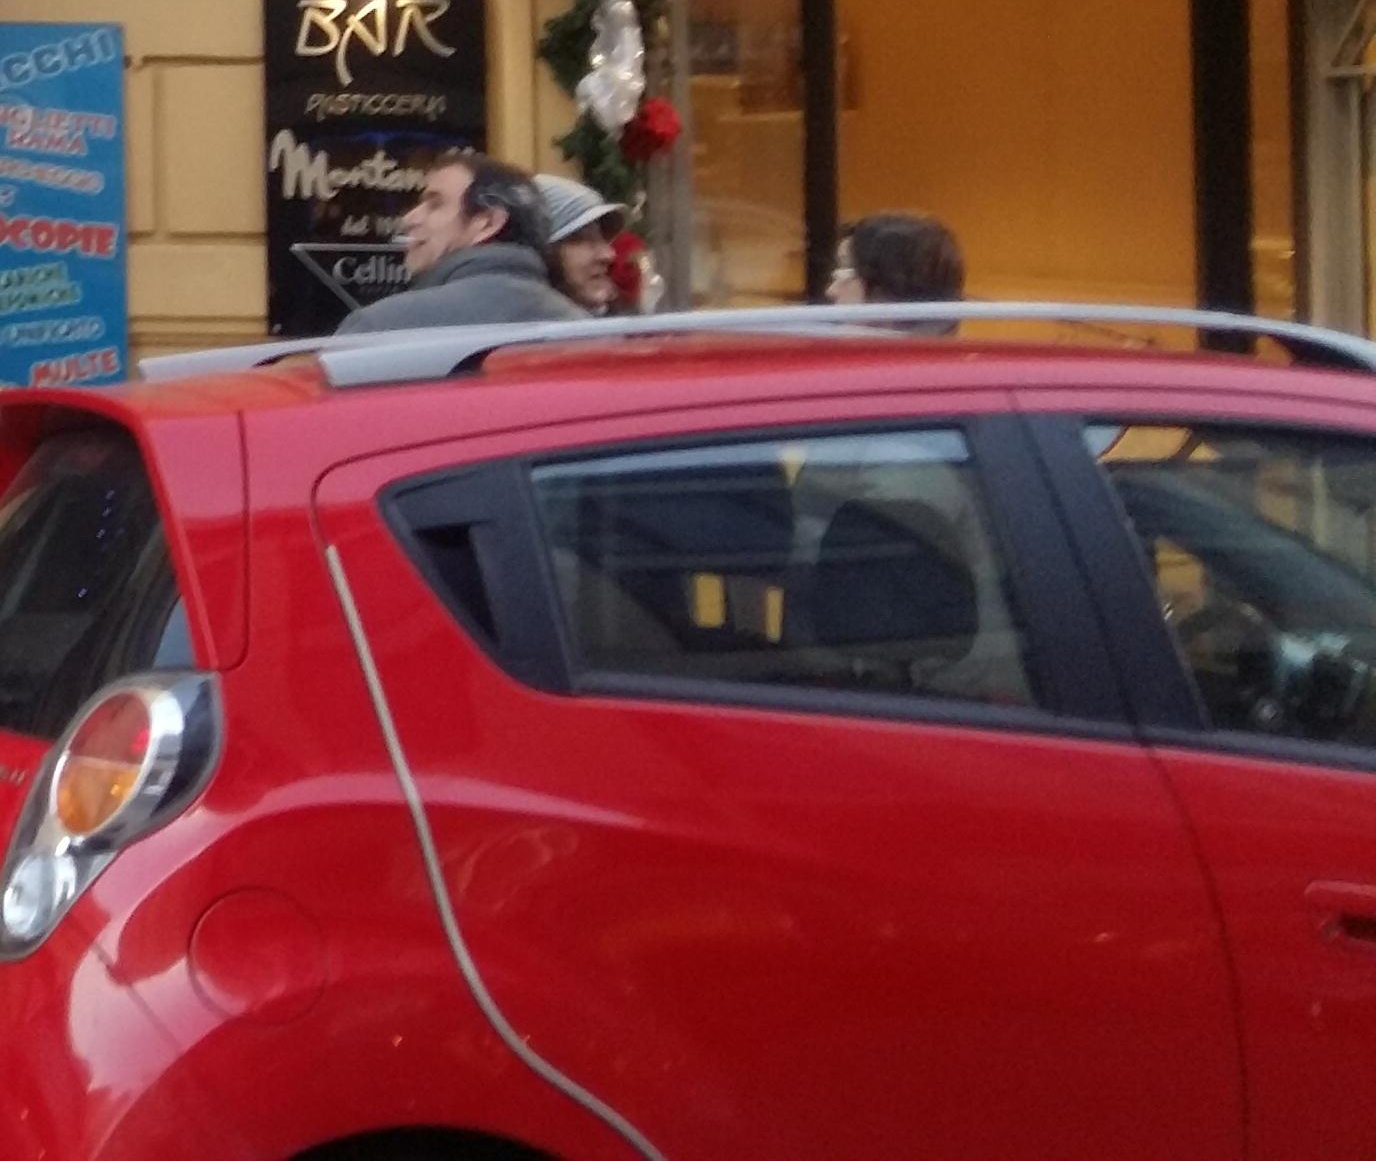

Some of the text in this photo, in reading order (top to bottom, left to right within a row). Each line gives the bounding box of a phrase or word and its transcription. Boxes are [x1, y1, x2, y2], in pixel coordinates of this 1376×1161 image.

[269, 128, 428, 201] Montan
[332, 255, 413, 285] Cellin
[31, 348, 119, 387] MULTE
